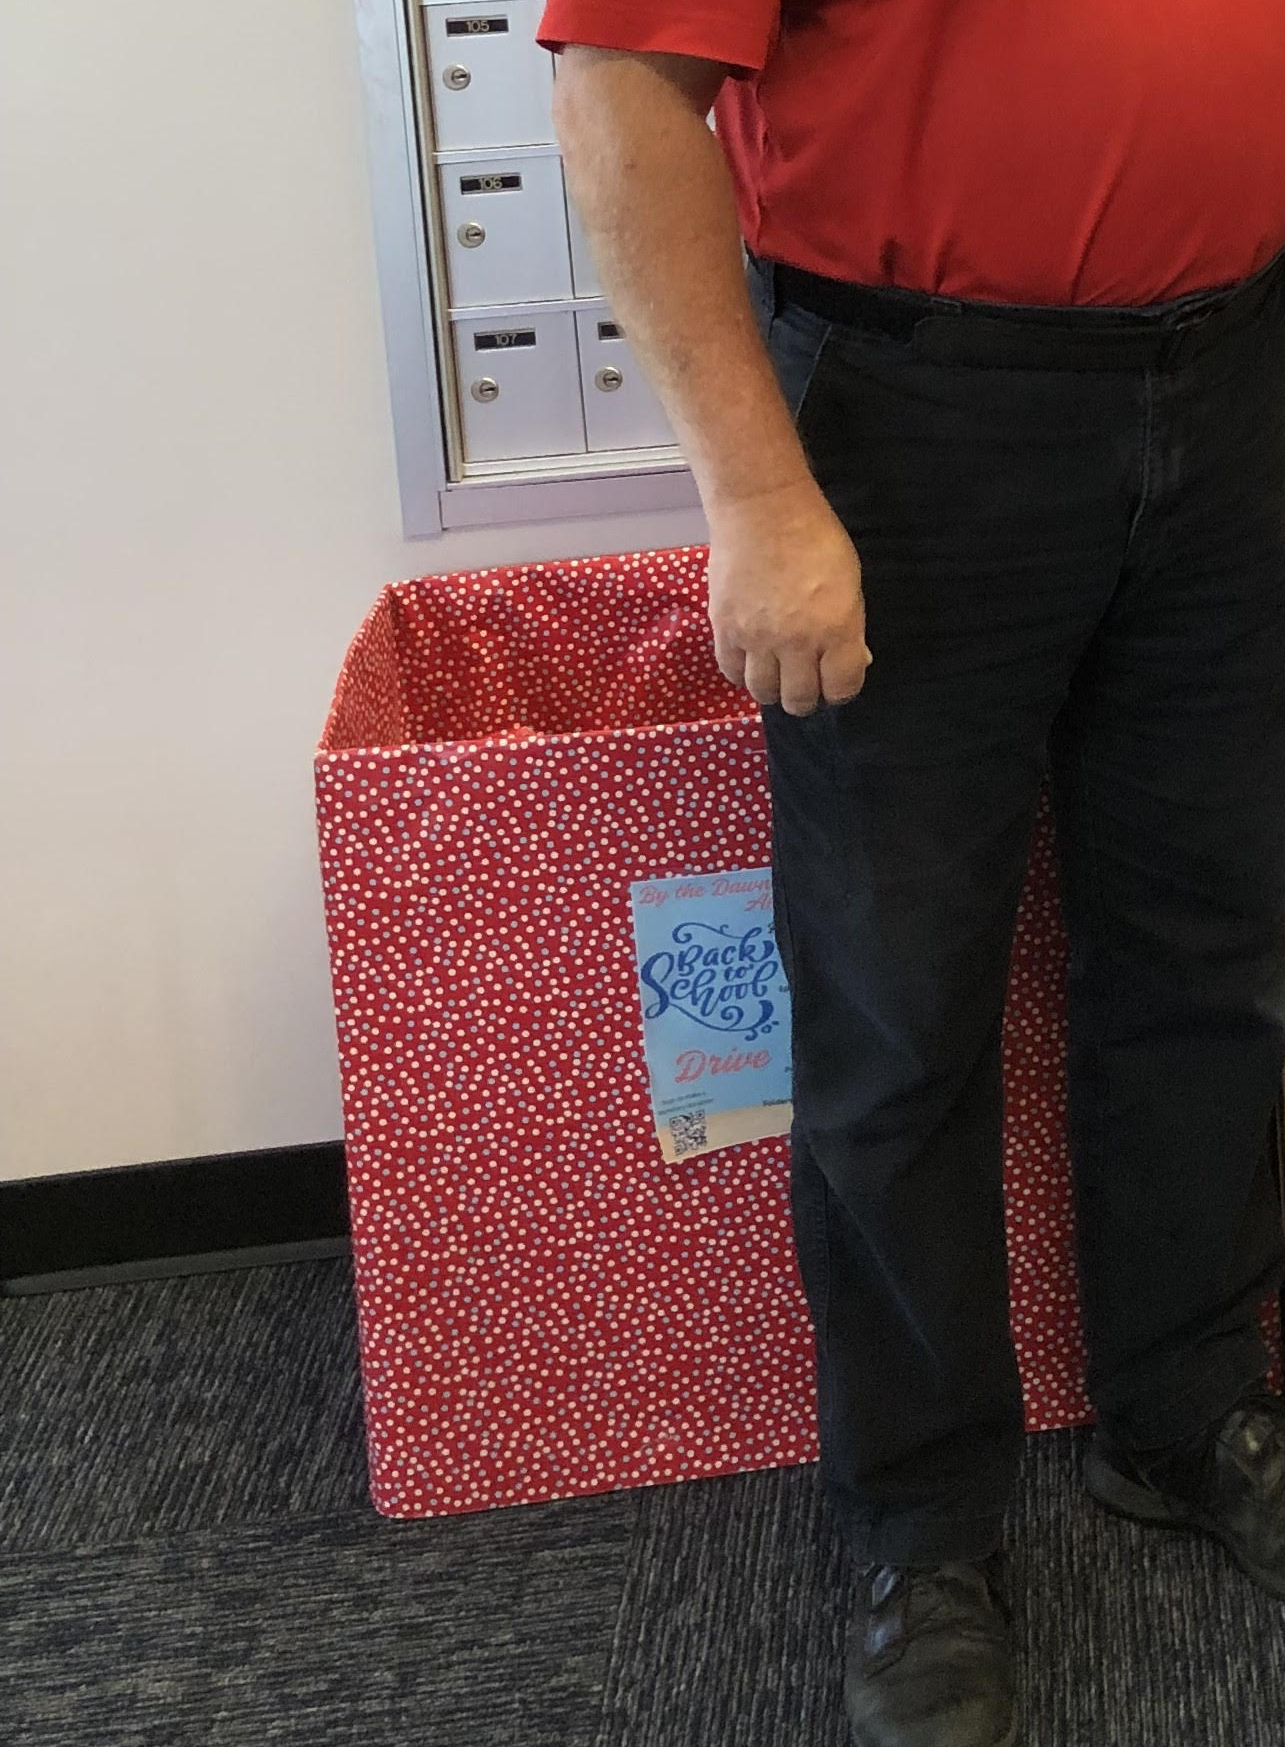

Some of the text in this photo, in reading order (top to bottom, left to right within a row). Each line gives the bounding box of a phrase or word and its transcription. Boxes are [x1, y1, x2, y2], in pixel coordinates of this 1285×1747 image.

[465, 20, 489, 33] 105
[494, 333, 517, 346] 107
[677, 926, 775, 977] Back
[641, 951, 779, 1020] School
[724, 963, 754, 983] to
[674, 1046, 774, 1084] Drive
